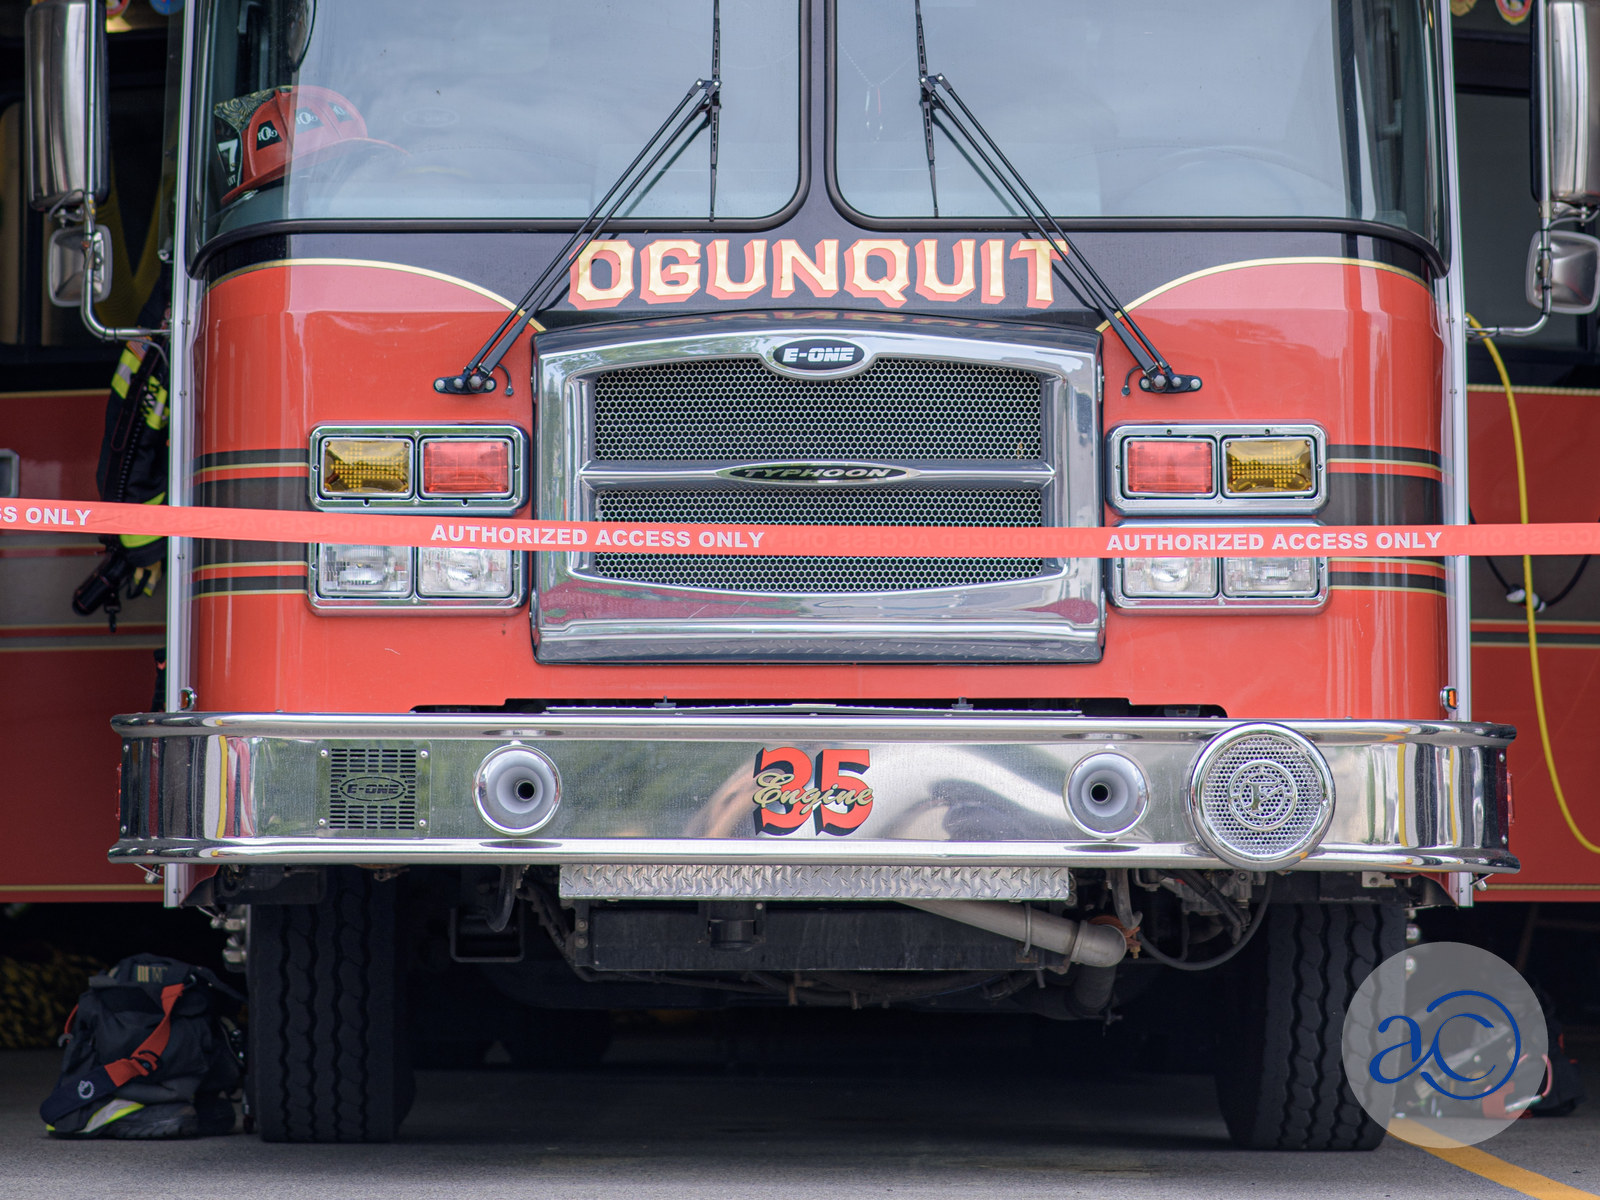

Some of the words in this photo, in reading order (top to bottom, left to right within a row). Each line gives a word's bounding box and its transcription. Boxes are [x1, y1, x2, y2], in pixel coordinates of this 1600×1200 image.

[568, 238, 1070, 311] OGUNQUIT
[782, 347, 855, 362] E-ONE
[744, 468, 892, 478] TYPHOON
[25, 507, 92, 526] ONLY
[431, 524, 588, 545] AUTHORIZED
[595, 530, 691, 548] ACCESS
[699, 531, 765, 549] ONLY
[1106, 534, 1265, 551] AUTHORIZED
[1272, 533, 1368, 550] ACCESS
[1375, 532, 1442, 549] ONLY
[346, 784, 399, 794] E-ONE
[753, 746, 874, 837] 35
[753, 772, 874, 815] Engine
